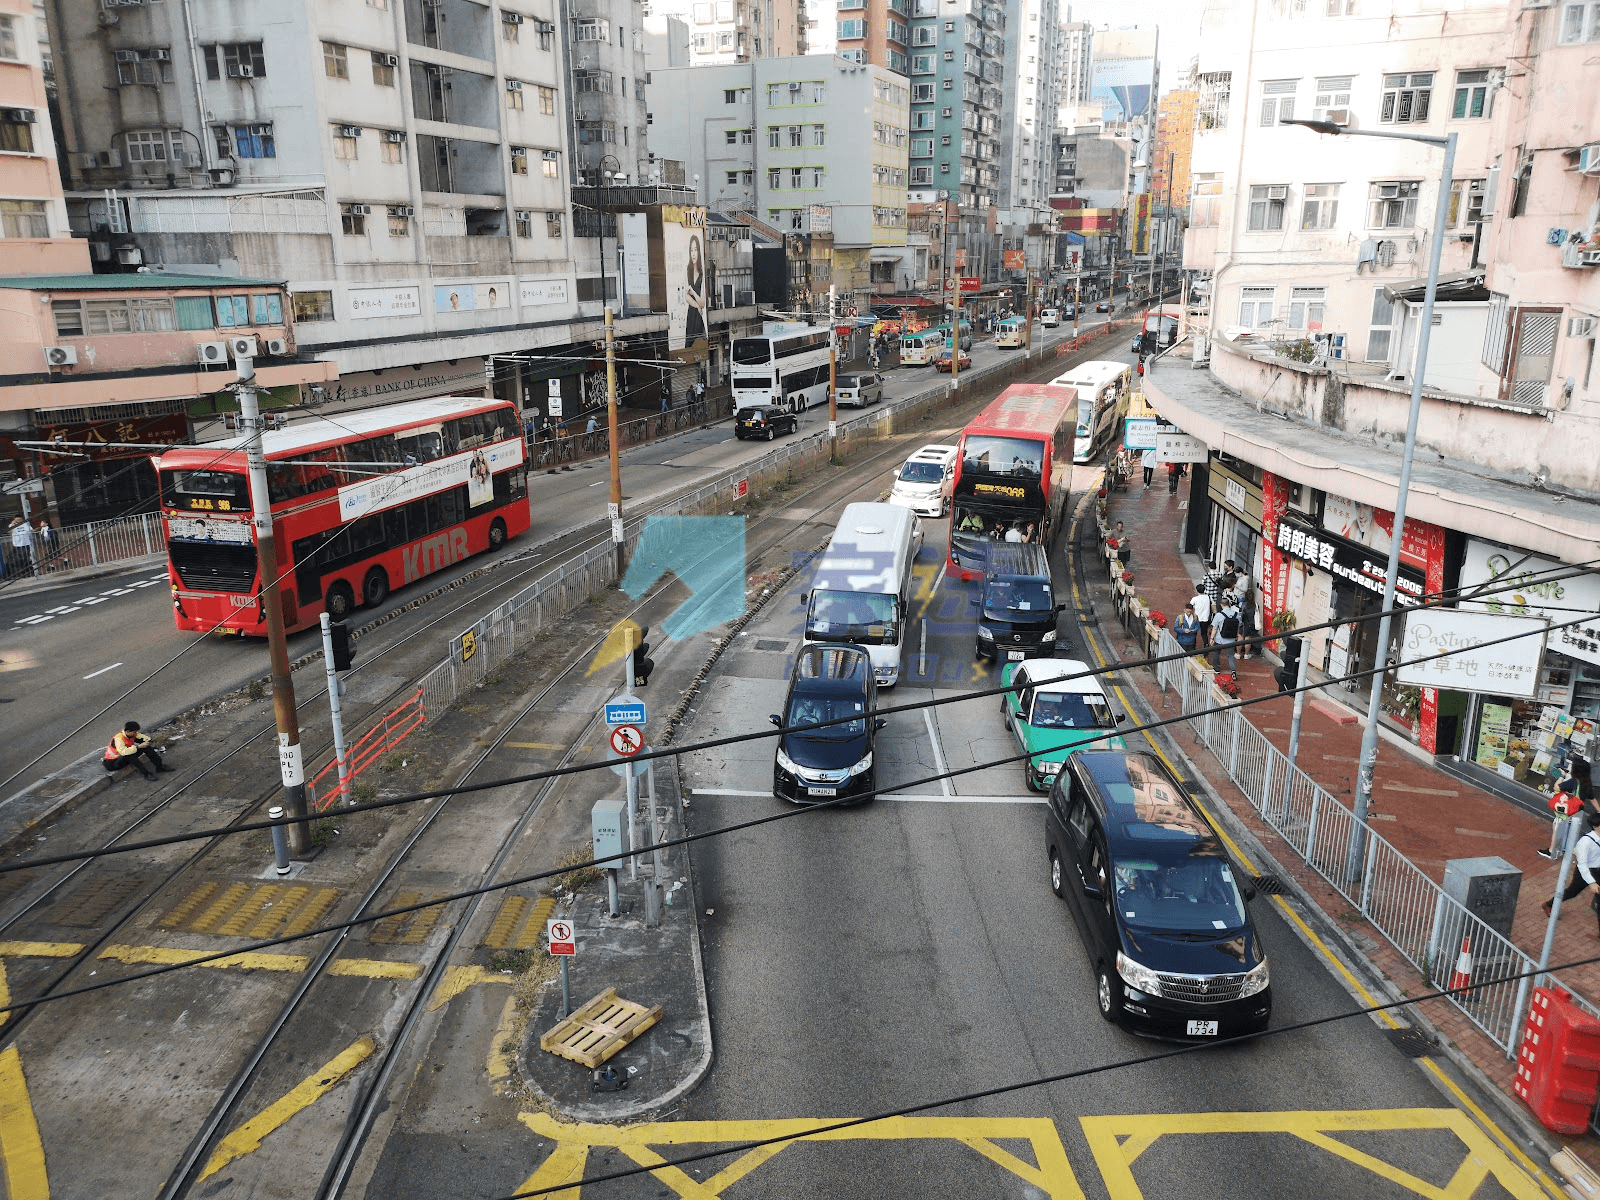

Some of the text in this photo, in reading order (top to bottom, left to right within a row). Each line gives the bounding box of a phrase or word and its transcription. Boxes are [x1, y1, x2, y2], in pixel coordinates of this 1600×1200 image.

[375, 381, 401, 394] BANK
[403, 379, 415, 391] OF
[417, 375, 447, 388] CHINA
[1277, 523, 1336, 571] 詩朗美容
[1396, 576, 1422, 595] 2006
[229, 594, 257, 608] KMB
[1408, 623, 1483, 650] Pasture
[1411, 653, 1479, 677] 青草地
[281, 761, 294, 769] PL
